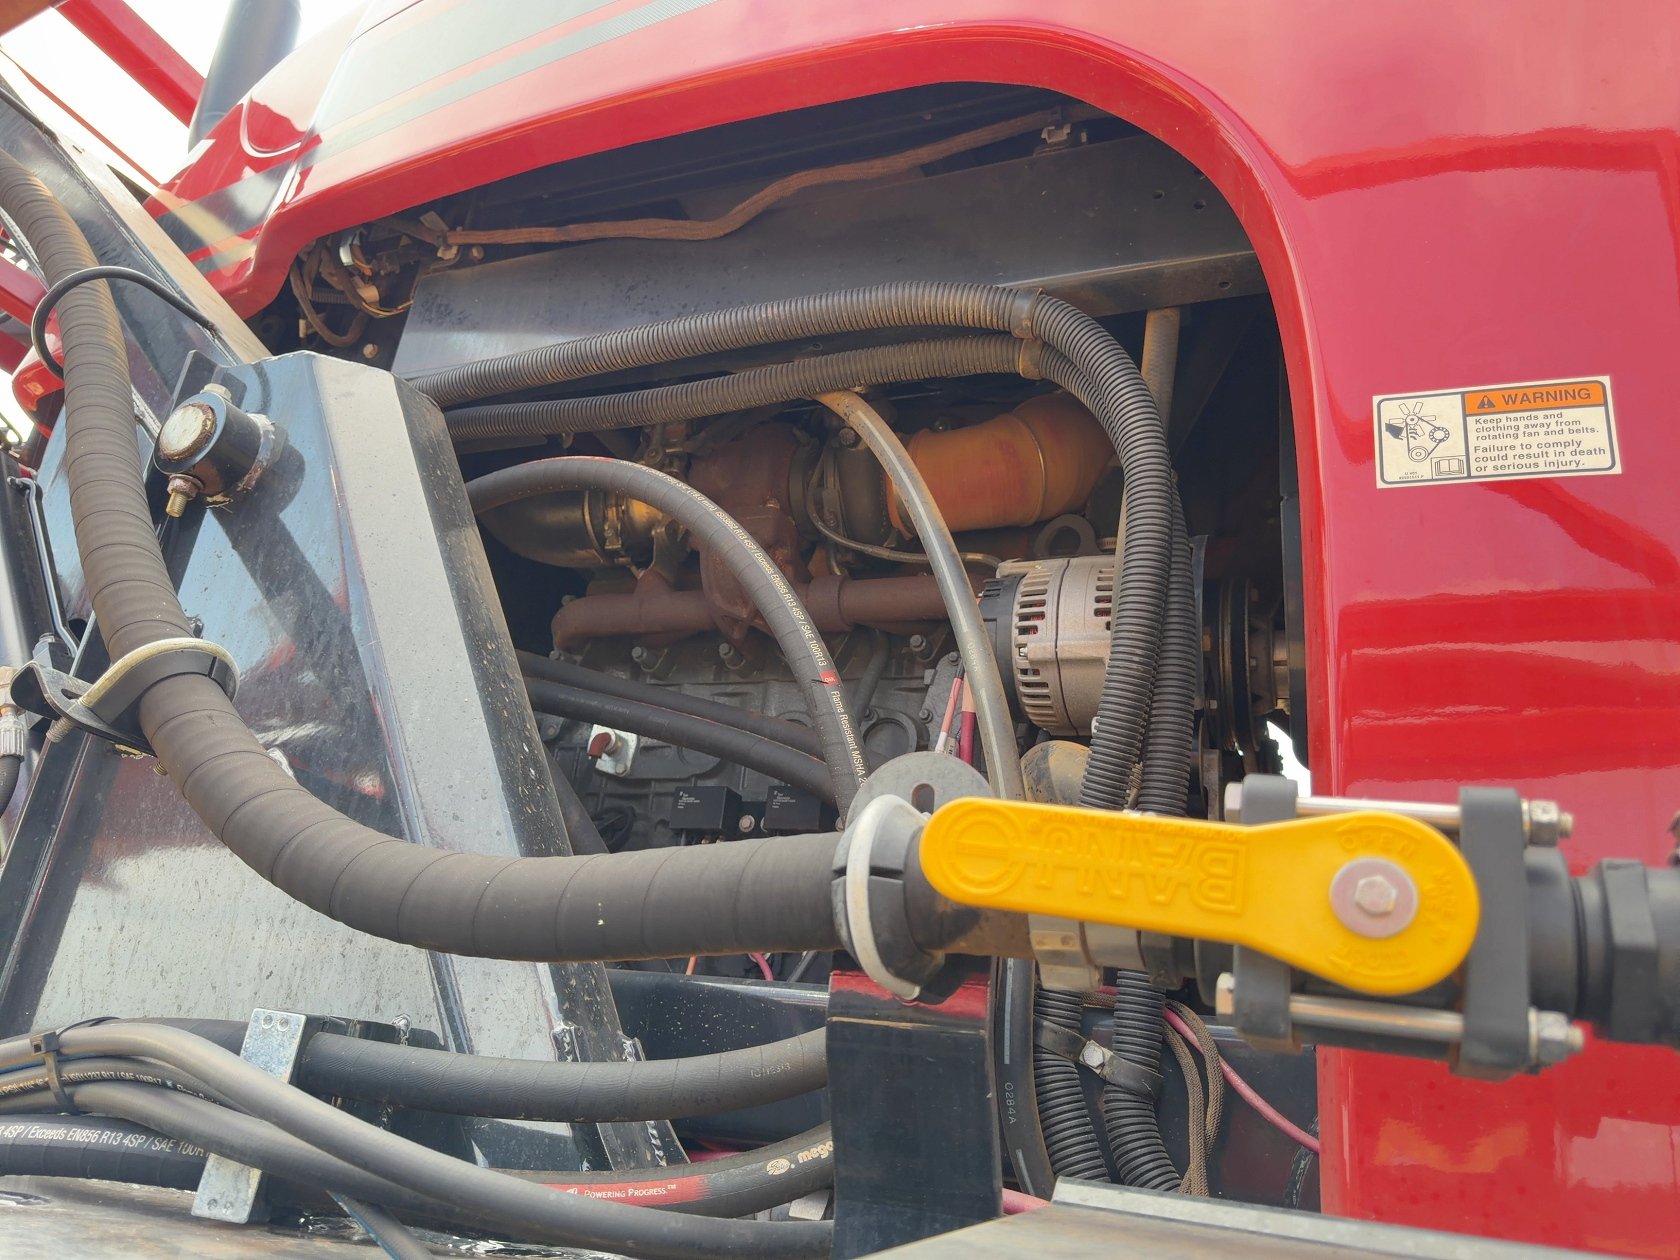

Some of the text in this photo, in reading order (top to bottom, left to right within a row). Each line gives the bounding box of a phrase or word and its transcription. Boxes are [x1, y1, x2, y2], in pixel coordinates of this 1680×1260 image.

[1502, 388, 1591, 406] WARNING
[1475, 418, 1581, 434] clothing away from
[1505, 413, 1539, 422] hands
[1476, 432, 1519, 442] rotating
[1568, 426, 1599, 435] belts.
[1474, 444, 1516, 453] Failure
[1536, 439, 1582, 450] comply
[1474, 447, 1606, 463] could result in death
[1493, 461, 1540, 471] serious
[1543, 459, 1585, 469] injury.
[754, 552, 775, 574] Exceeds
[770, 574, 788, 594] EN856
[784, 593, 797, 608] R13
[792, 606, 805, 622] 4SP
[801, 624, 815, 640] SAE
[808, 639, 828, 666] 100R13
[831, 690, 845, 713] Flame
[840, 714, 857, 750] Resistant
[851, 748, 866, 776] MSHA
[1340, 831, 1417, 858] OPEN
[1004, 1082, 1017, 1124] 0284A
[3, 1125, 24, 1138] 4SP
[28, 1126, 67, 1140] Exceeds
[66, 1128, 101, 1143] EN856
[100, 1131, 122, 1145] R13
[122, 1134, 146, 1148] 4SP
[151, 1138, 177, 1152] SAE
